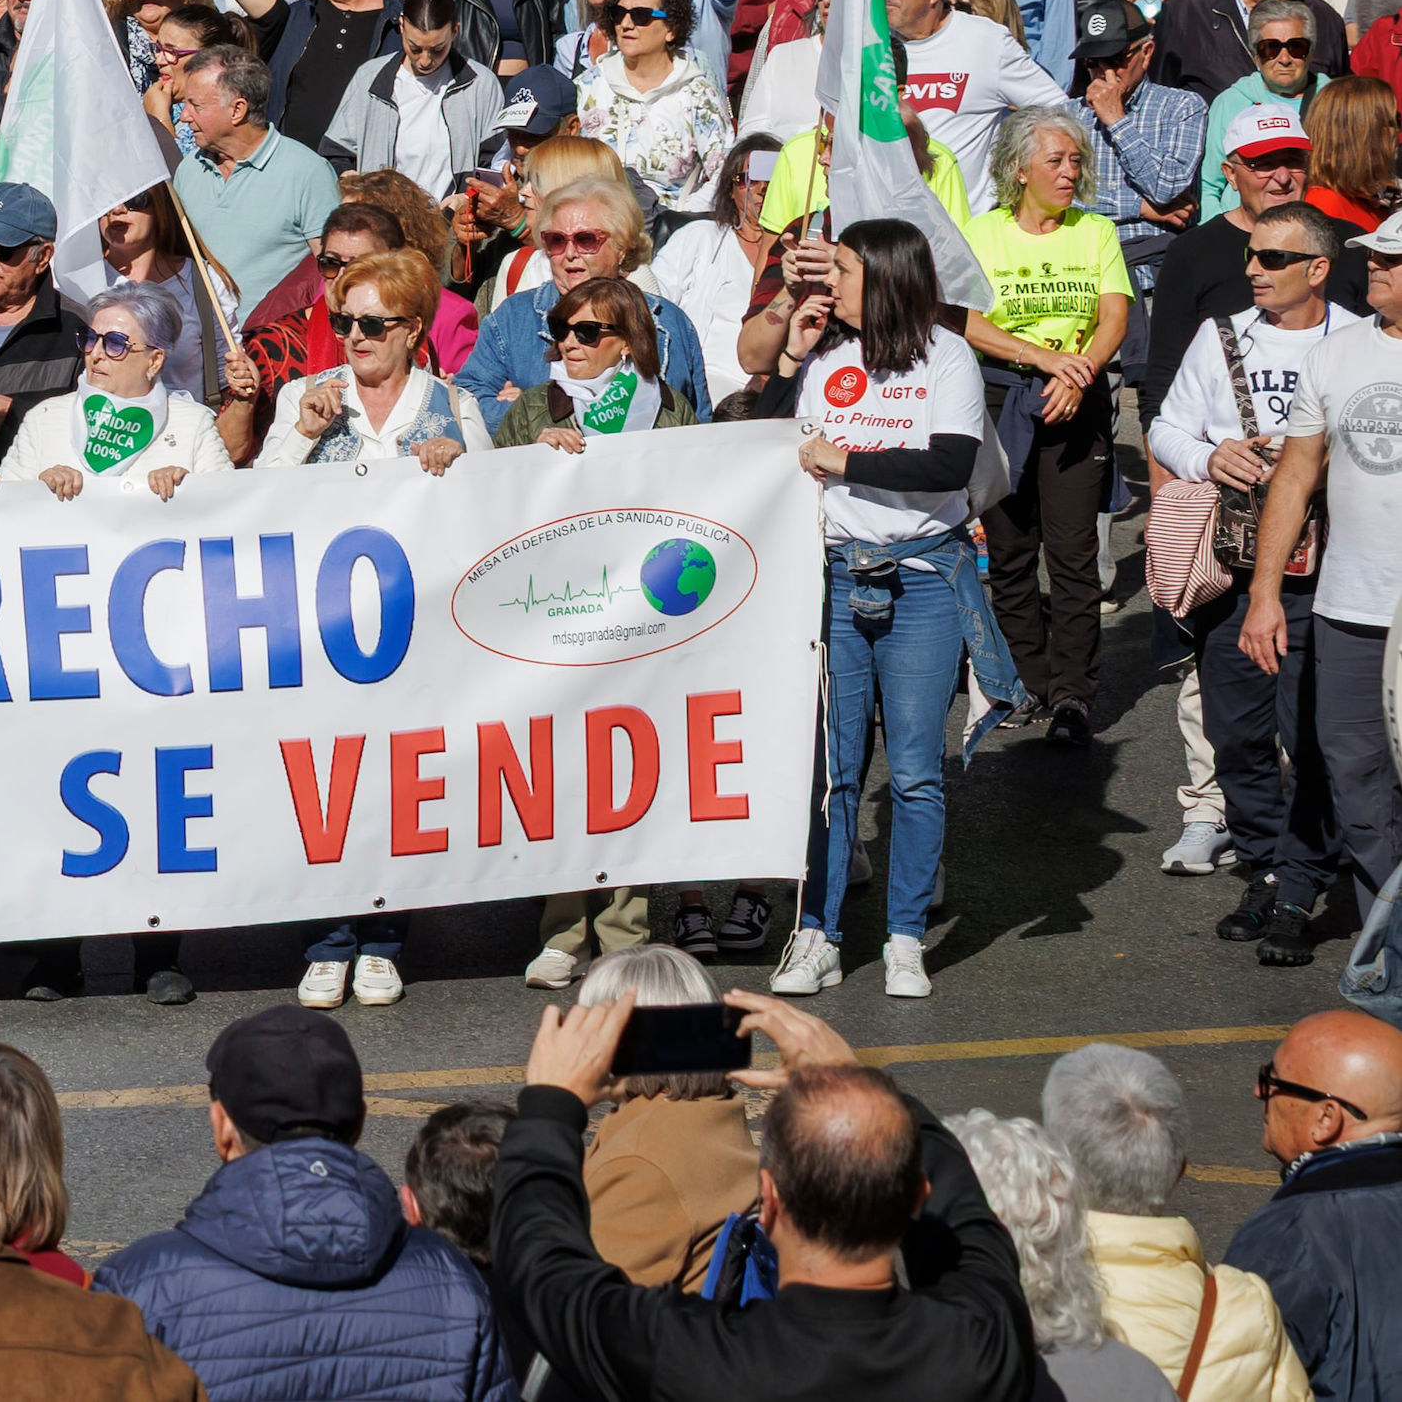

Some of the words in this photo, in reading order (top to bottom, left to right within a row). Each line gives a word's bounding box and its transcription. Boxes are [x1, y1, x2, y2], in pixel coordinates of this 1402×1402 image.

[1015, 281, 1099, 296] MEMORIAL
[1023, 296, 1050, 315] MIGUEL
[828, 385, 856, 404] UGT
[882, 386, 913, 400] UGT
[590, 405, 626, 427] 100%
[824, 410, 845, 424] Lo
[849, 412, 914, 429] Primero
[86, 441, 122, 461] 100%
[468, 554, 502, 585] MESA
[502, 540, 521, 561] EN
[522, 524, 578, 551] DEFENSA
[579, 518, 596, 531] DE
[597, 513, 613, 526] LA
[616, 511, 674, 528] SANIDAD
[676, 518, 731, 545] PÚBLICA
[548, 602, 605, 618] GRANADA
[552, 619, 667, 647] mdspgranada@gmail.com
[58, 743, 219, 879] SE
[278, 689, 751, 865] VENDE
